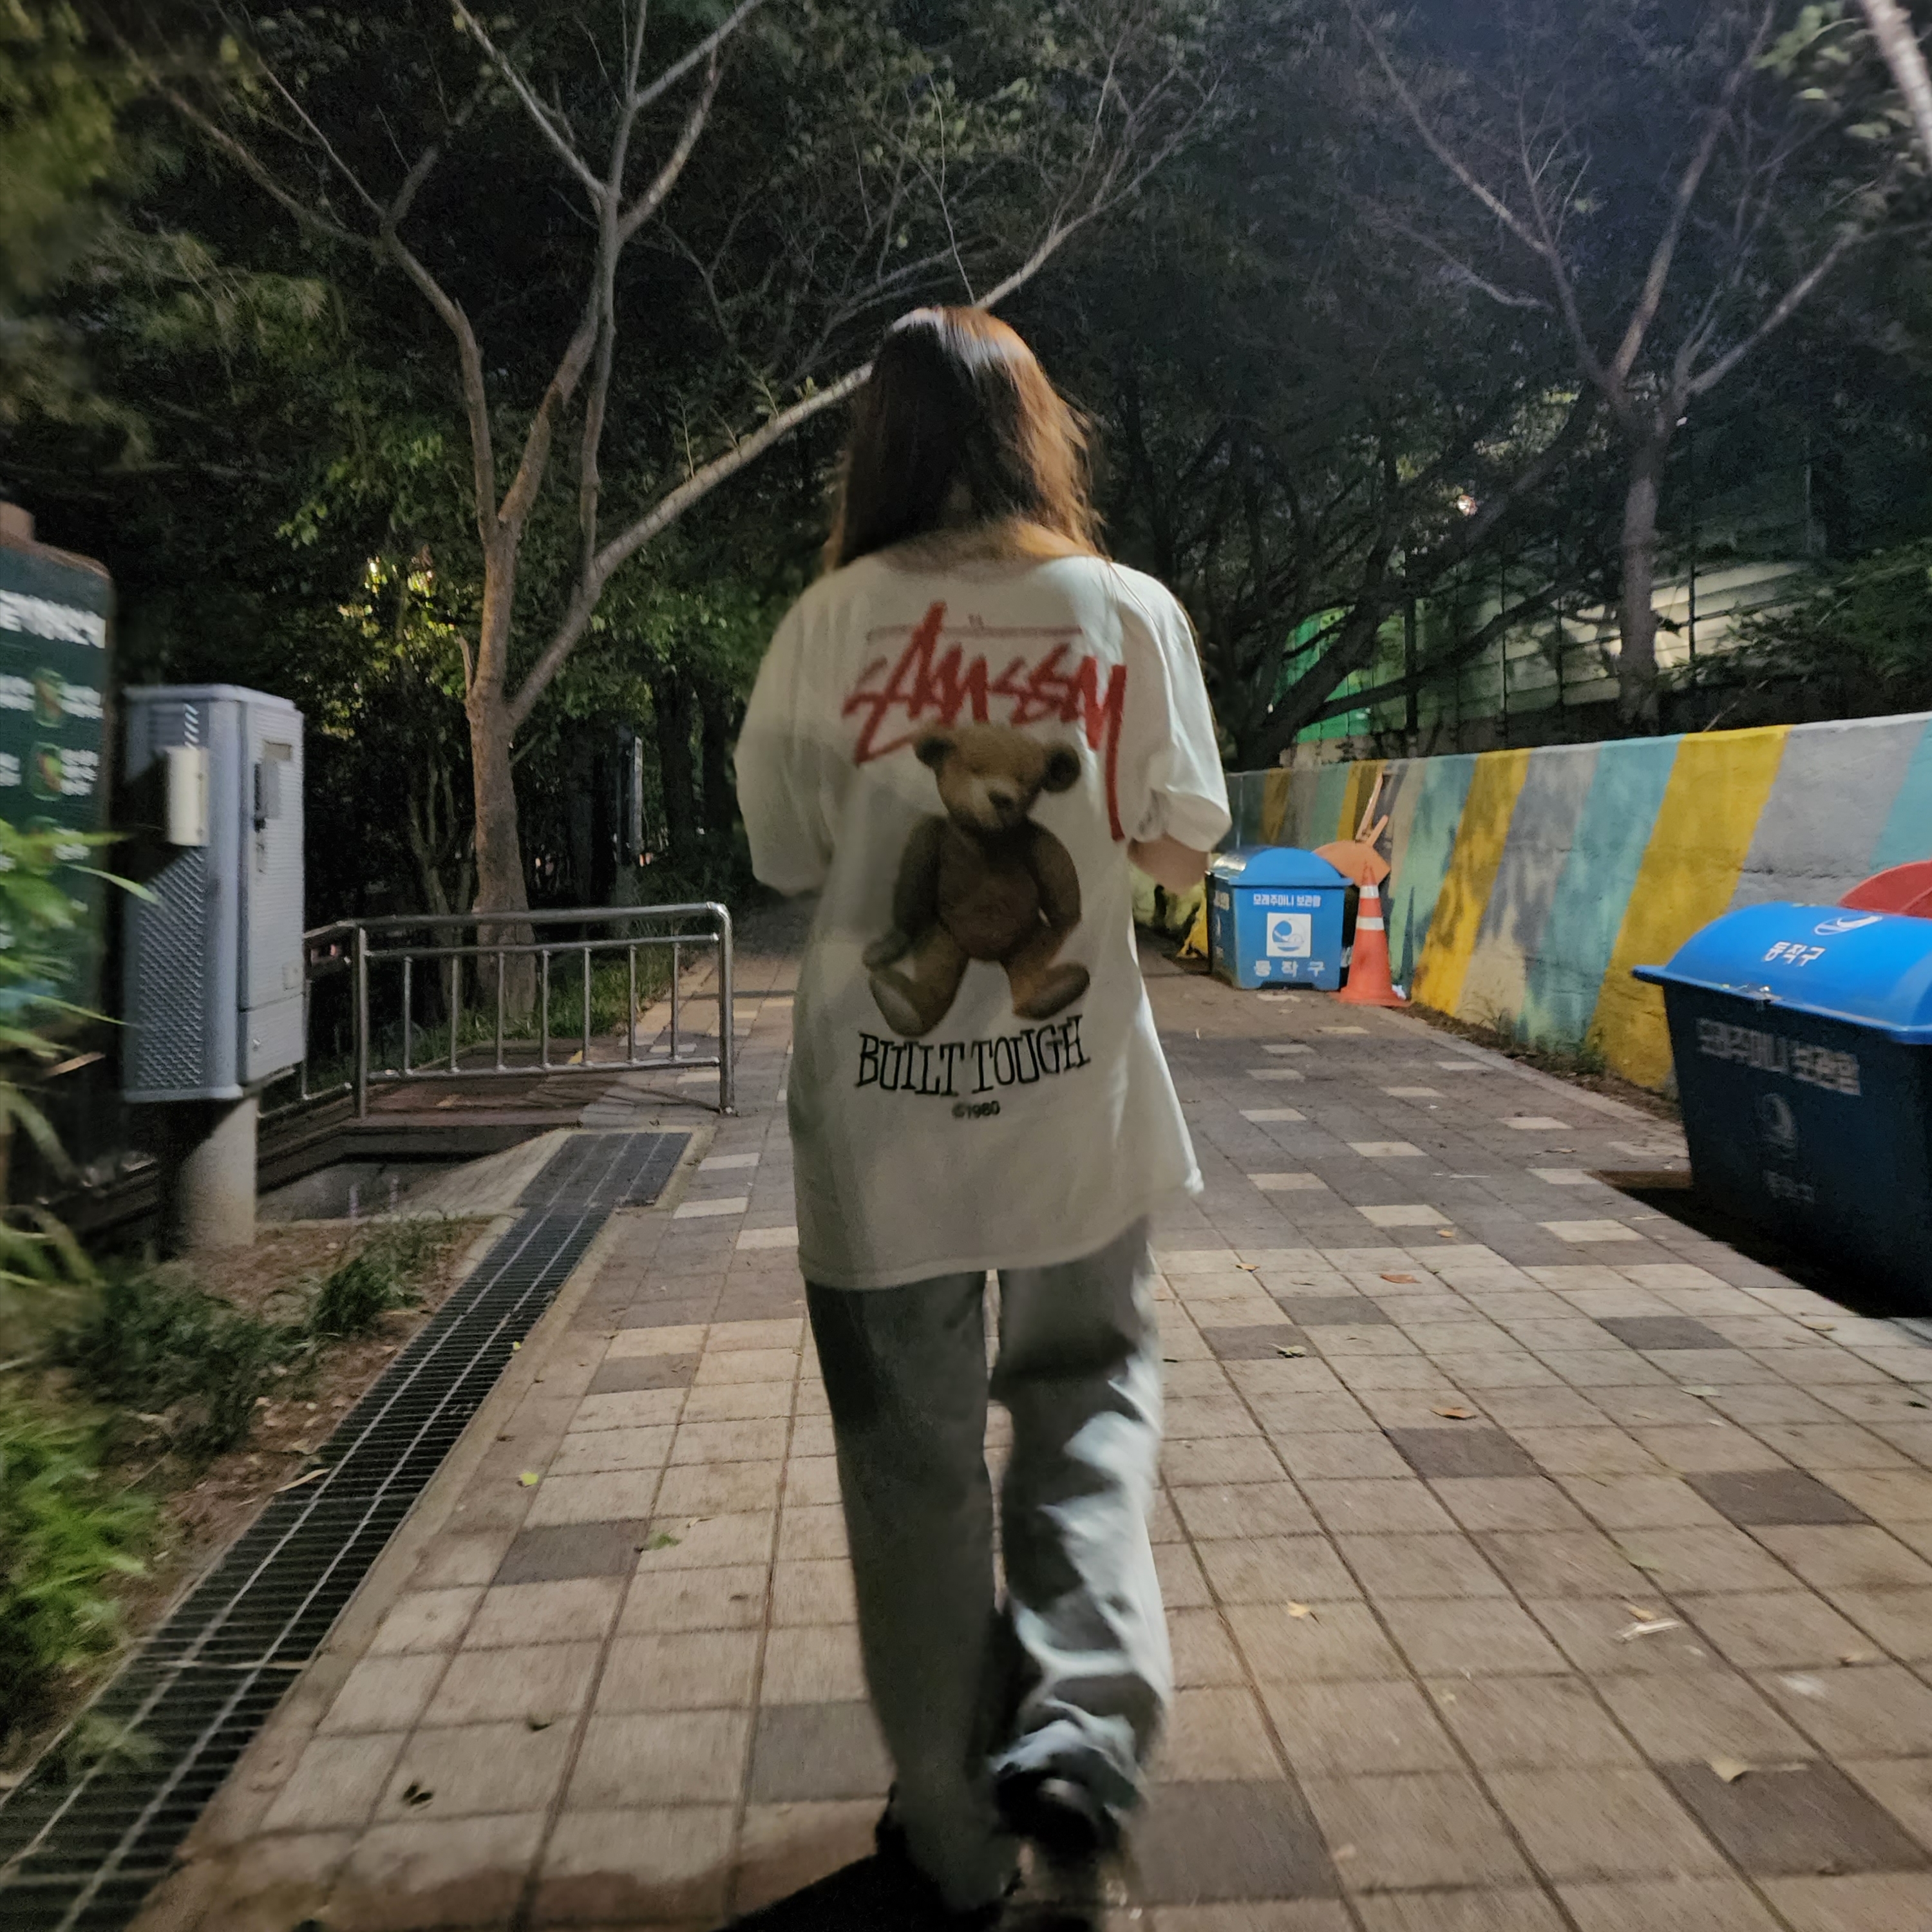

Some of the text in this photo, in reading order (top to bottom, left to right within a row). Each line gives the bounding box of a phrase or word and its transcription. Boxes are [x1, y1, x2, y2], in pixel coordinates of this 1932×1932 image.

[1763, 940, 1826, 967] 동작구
[855, 1015, 1091, 1096] BUILT TOUGH
